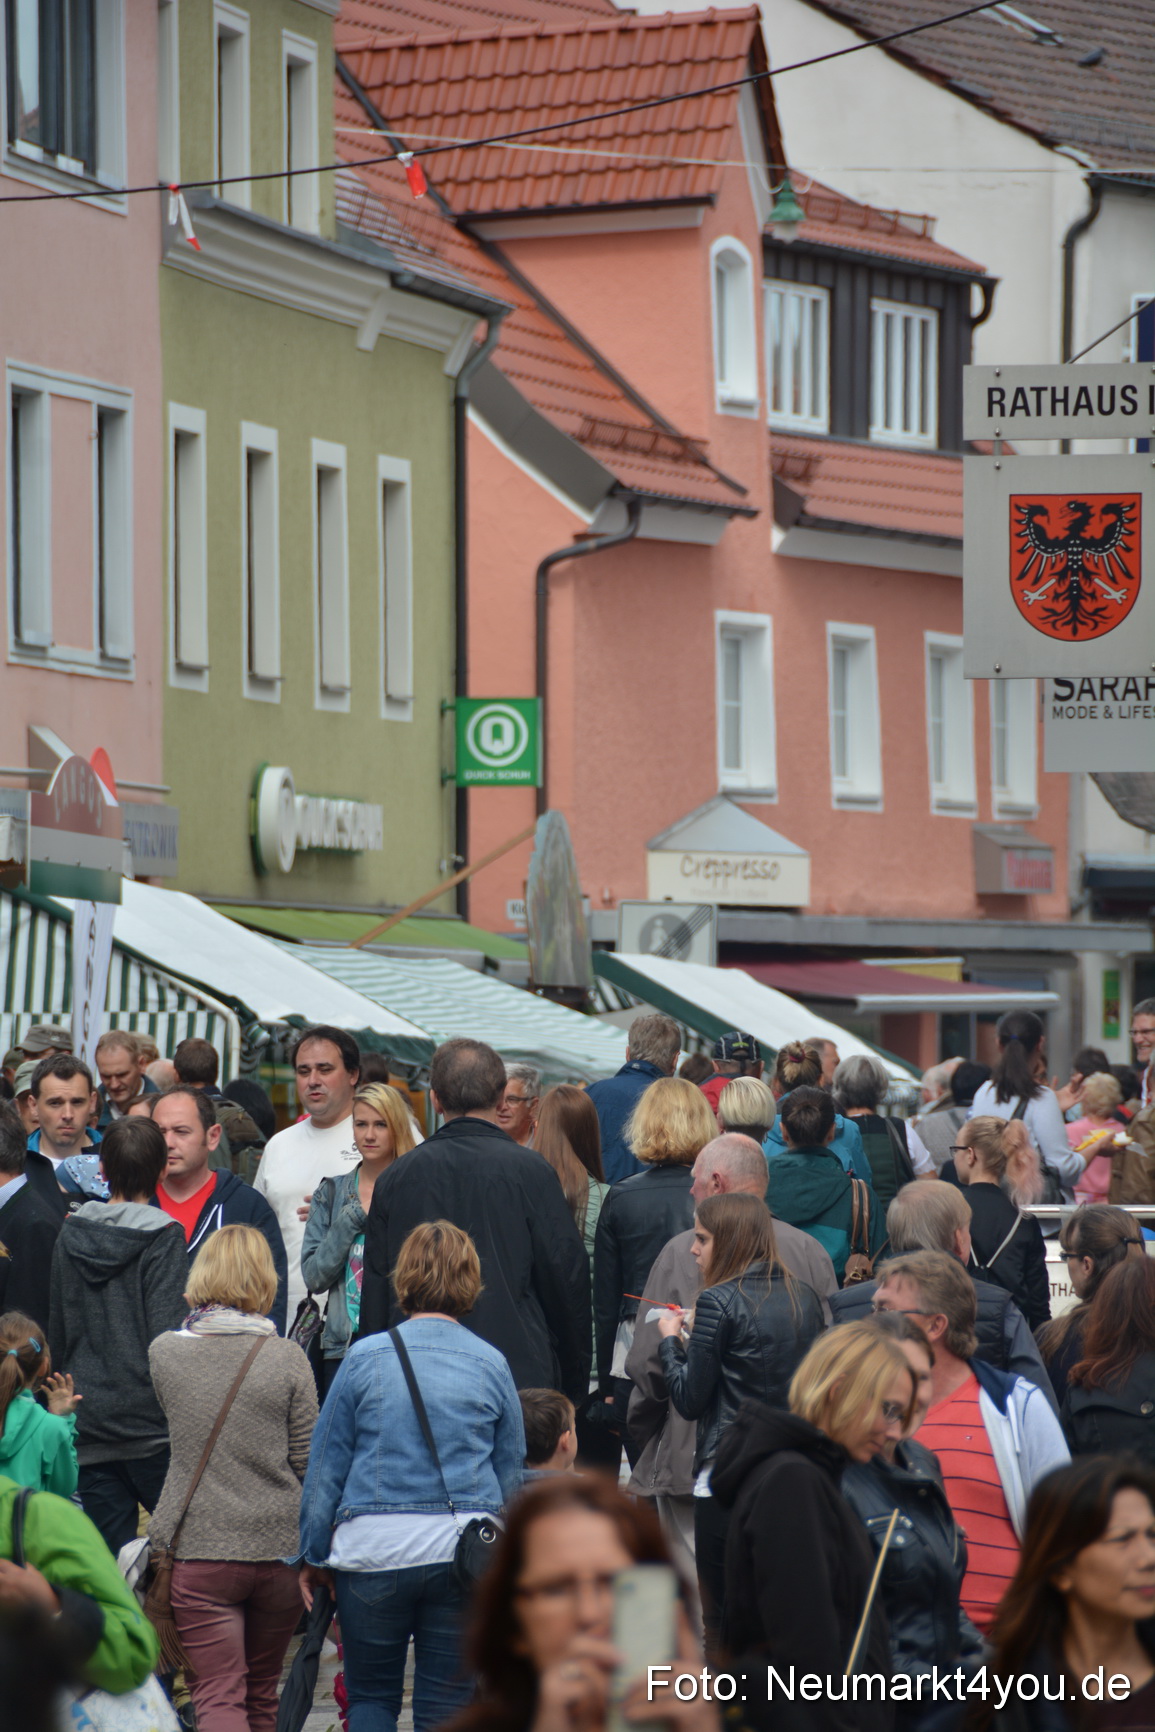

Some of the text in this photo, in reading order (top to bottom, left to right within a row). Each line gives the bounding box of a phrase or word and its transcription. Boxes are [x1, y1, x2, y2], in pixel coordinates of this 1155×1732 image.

[987, 385, 1138, 417] RATHAUS
[1052, 705, 1155, 719] MODE & LIFE
[497, 770, 531, 781] SCHUH
